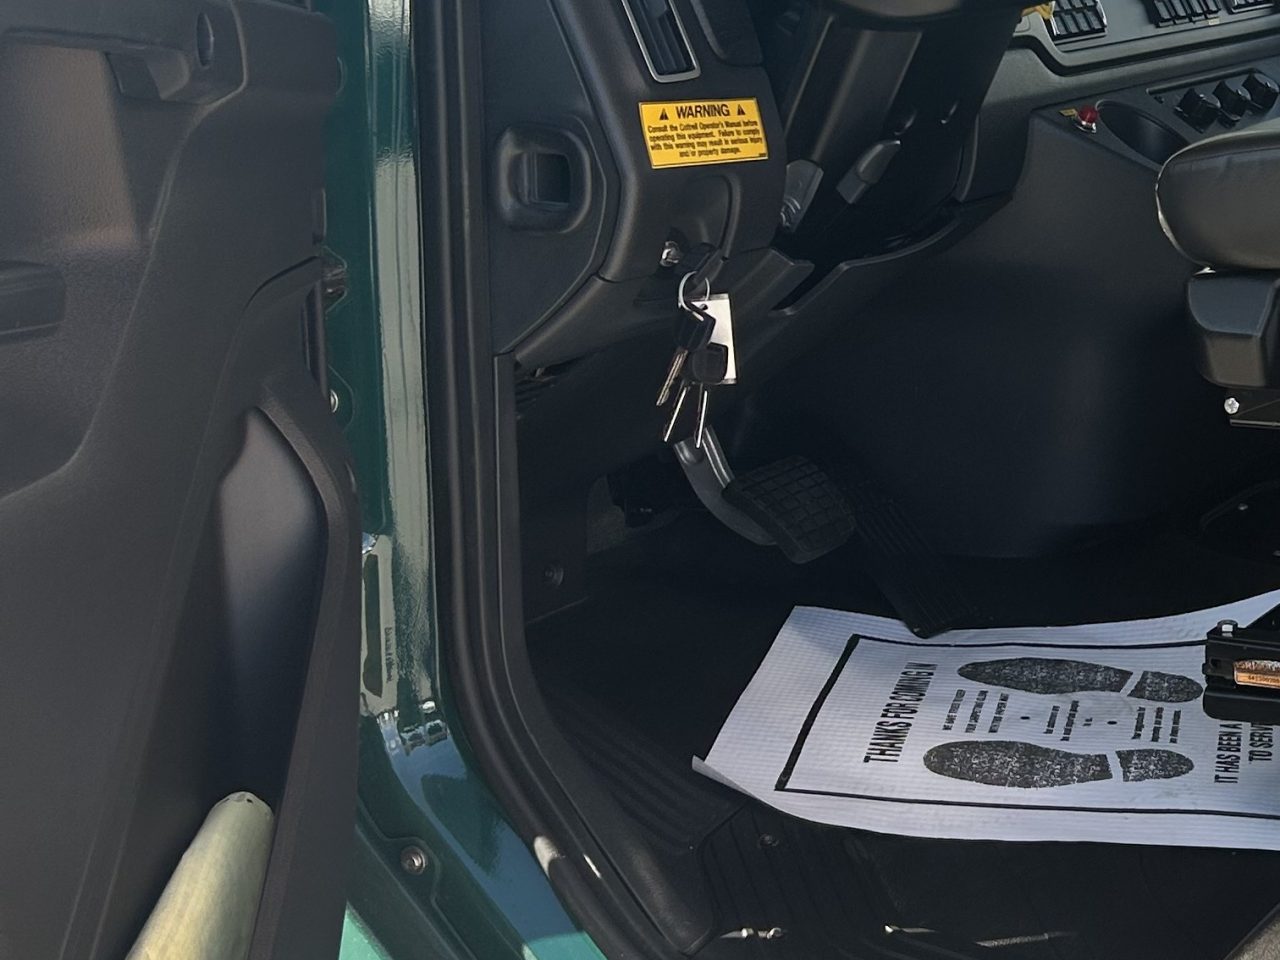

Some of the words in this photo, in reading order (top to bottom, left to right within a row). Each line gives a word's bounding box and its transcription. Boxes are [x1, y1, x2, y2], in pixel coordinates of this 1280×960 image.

[675, 104, 730, 118] WARNING
[649, 134, 674, 142] operating
[742, 128, 759, 136] comply
[675, 142, 695, 150] warning
[904, 662, 937, 670] IN
[889, 671, 934, 701] COMING
[881, 703, 919, 719] FOR
[864, 721, 912, 762] THANKS
[1218, 731, 1241, 752] BEEN
[1249, 750, 1272, 762] TO
[1215, 754, 1240, 773] HAS
[1214, 775, 1238, 783] IT
